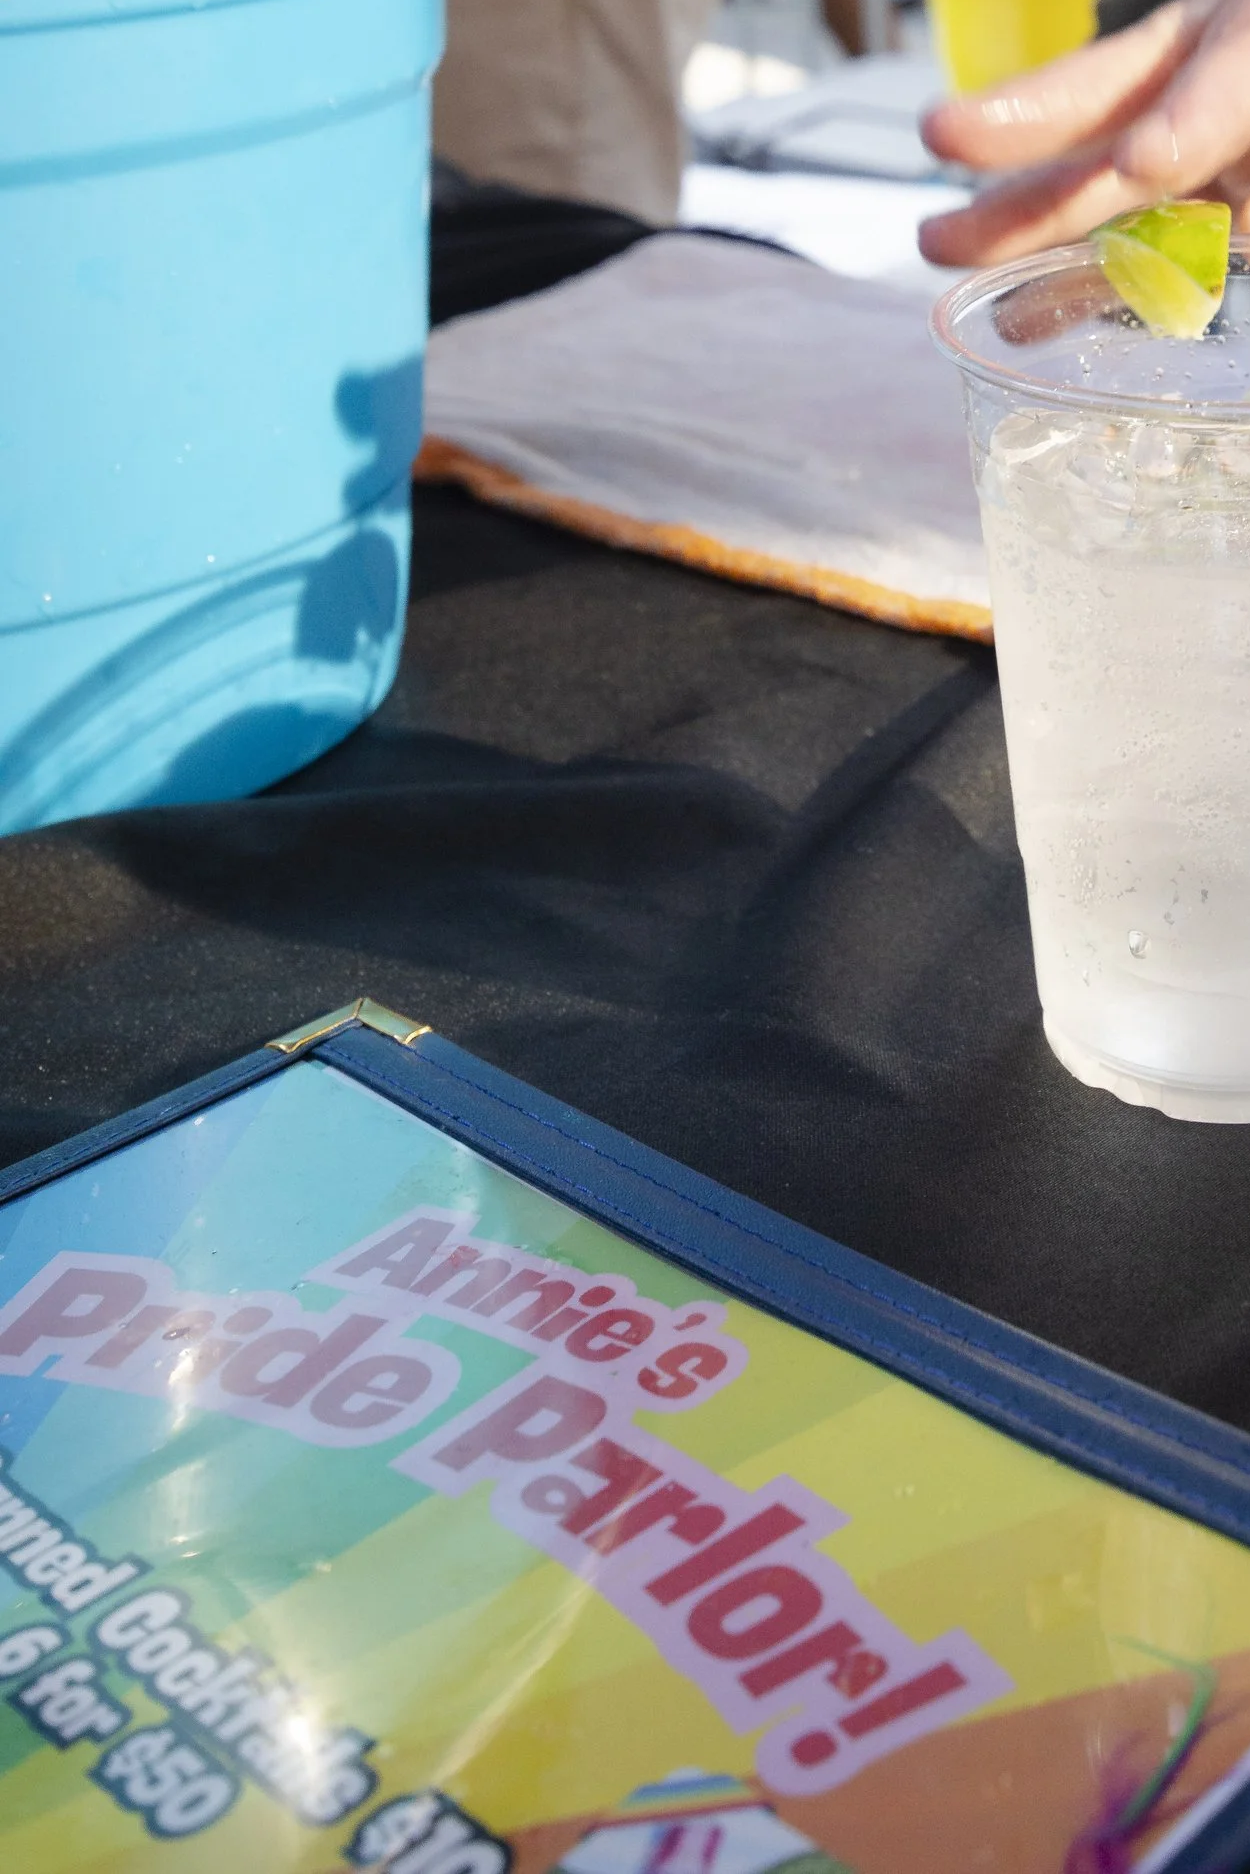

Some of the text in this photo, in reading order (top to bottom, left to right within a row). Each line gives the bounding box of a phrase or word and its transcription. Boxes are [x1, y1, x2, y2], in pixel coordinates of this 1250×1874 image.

[332, 1215, 729, 1401] Annie's
[0, 1266, 968, 1769] Pride Parlor!
[0, 1456, 139, 1613] nned
[0, 1626, 234, 1832] 6 for $50
